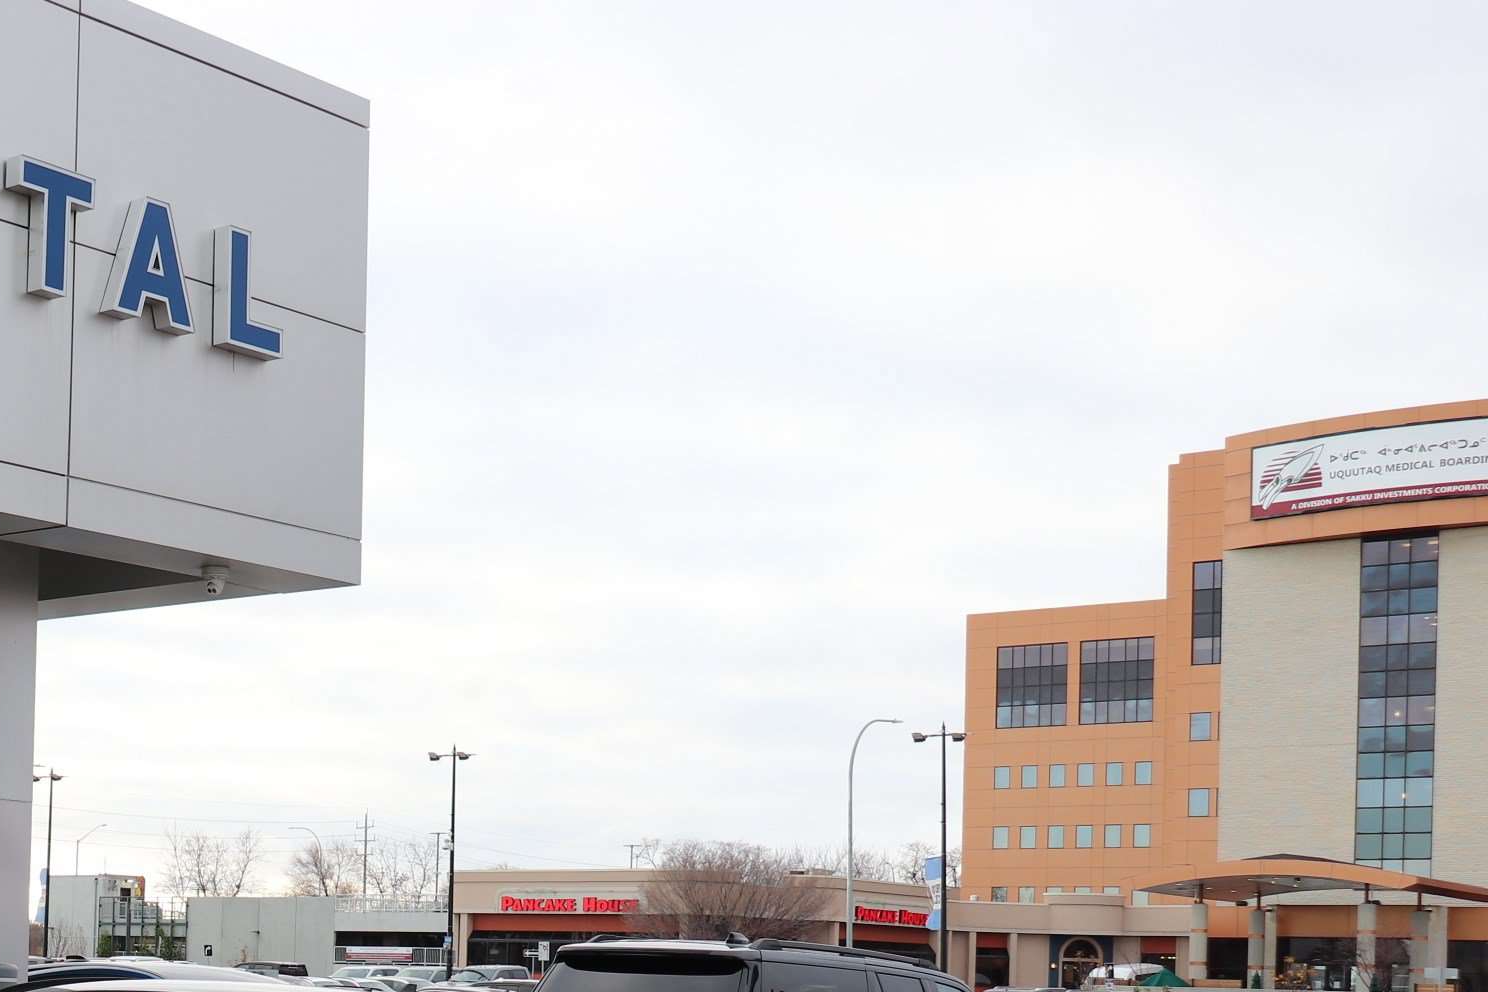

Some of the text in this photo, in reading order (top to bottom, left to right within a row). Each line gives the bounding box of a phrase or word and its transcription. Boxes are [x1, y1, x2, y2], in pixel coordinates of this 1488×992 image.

[1329, 466, 1383, 480] UQUUTAQ
[1384, 459, 1435, 473] MEDICAL
[1297, 498, 1333, 509] DIVISION
[1333, 496, 1345, 505] OF
[1374, 487, 1433, 500] INVESTMENTS
[501, 896, 577, 912] PANCAKE
[855, 905, 898, 923] PANCAKE
